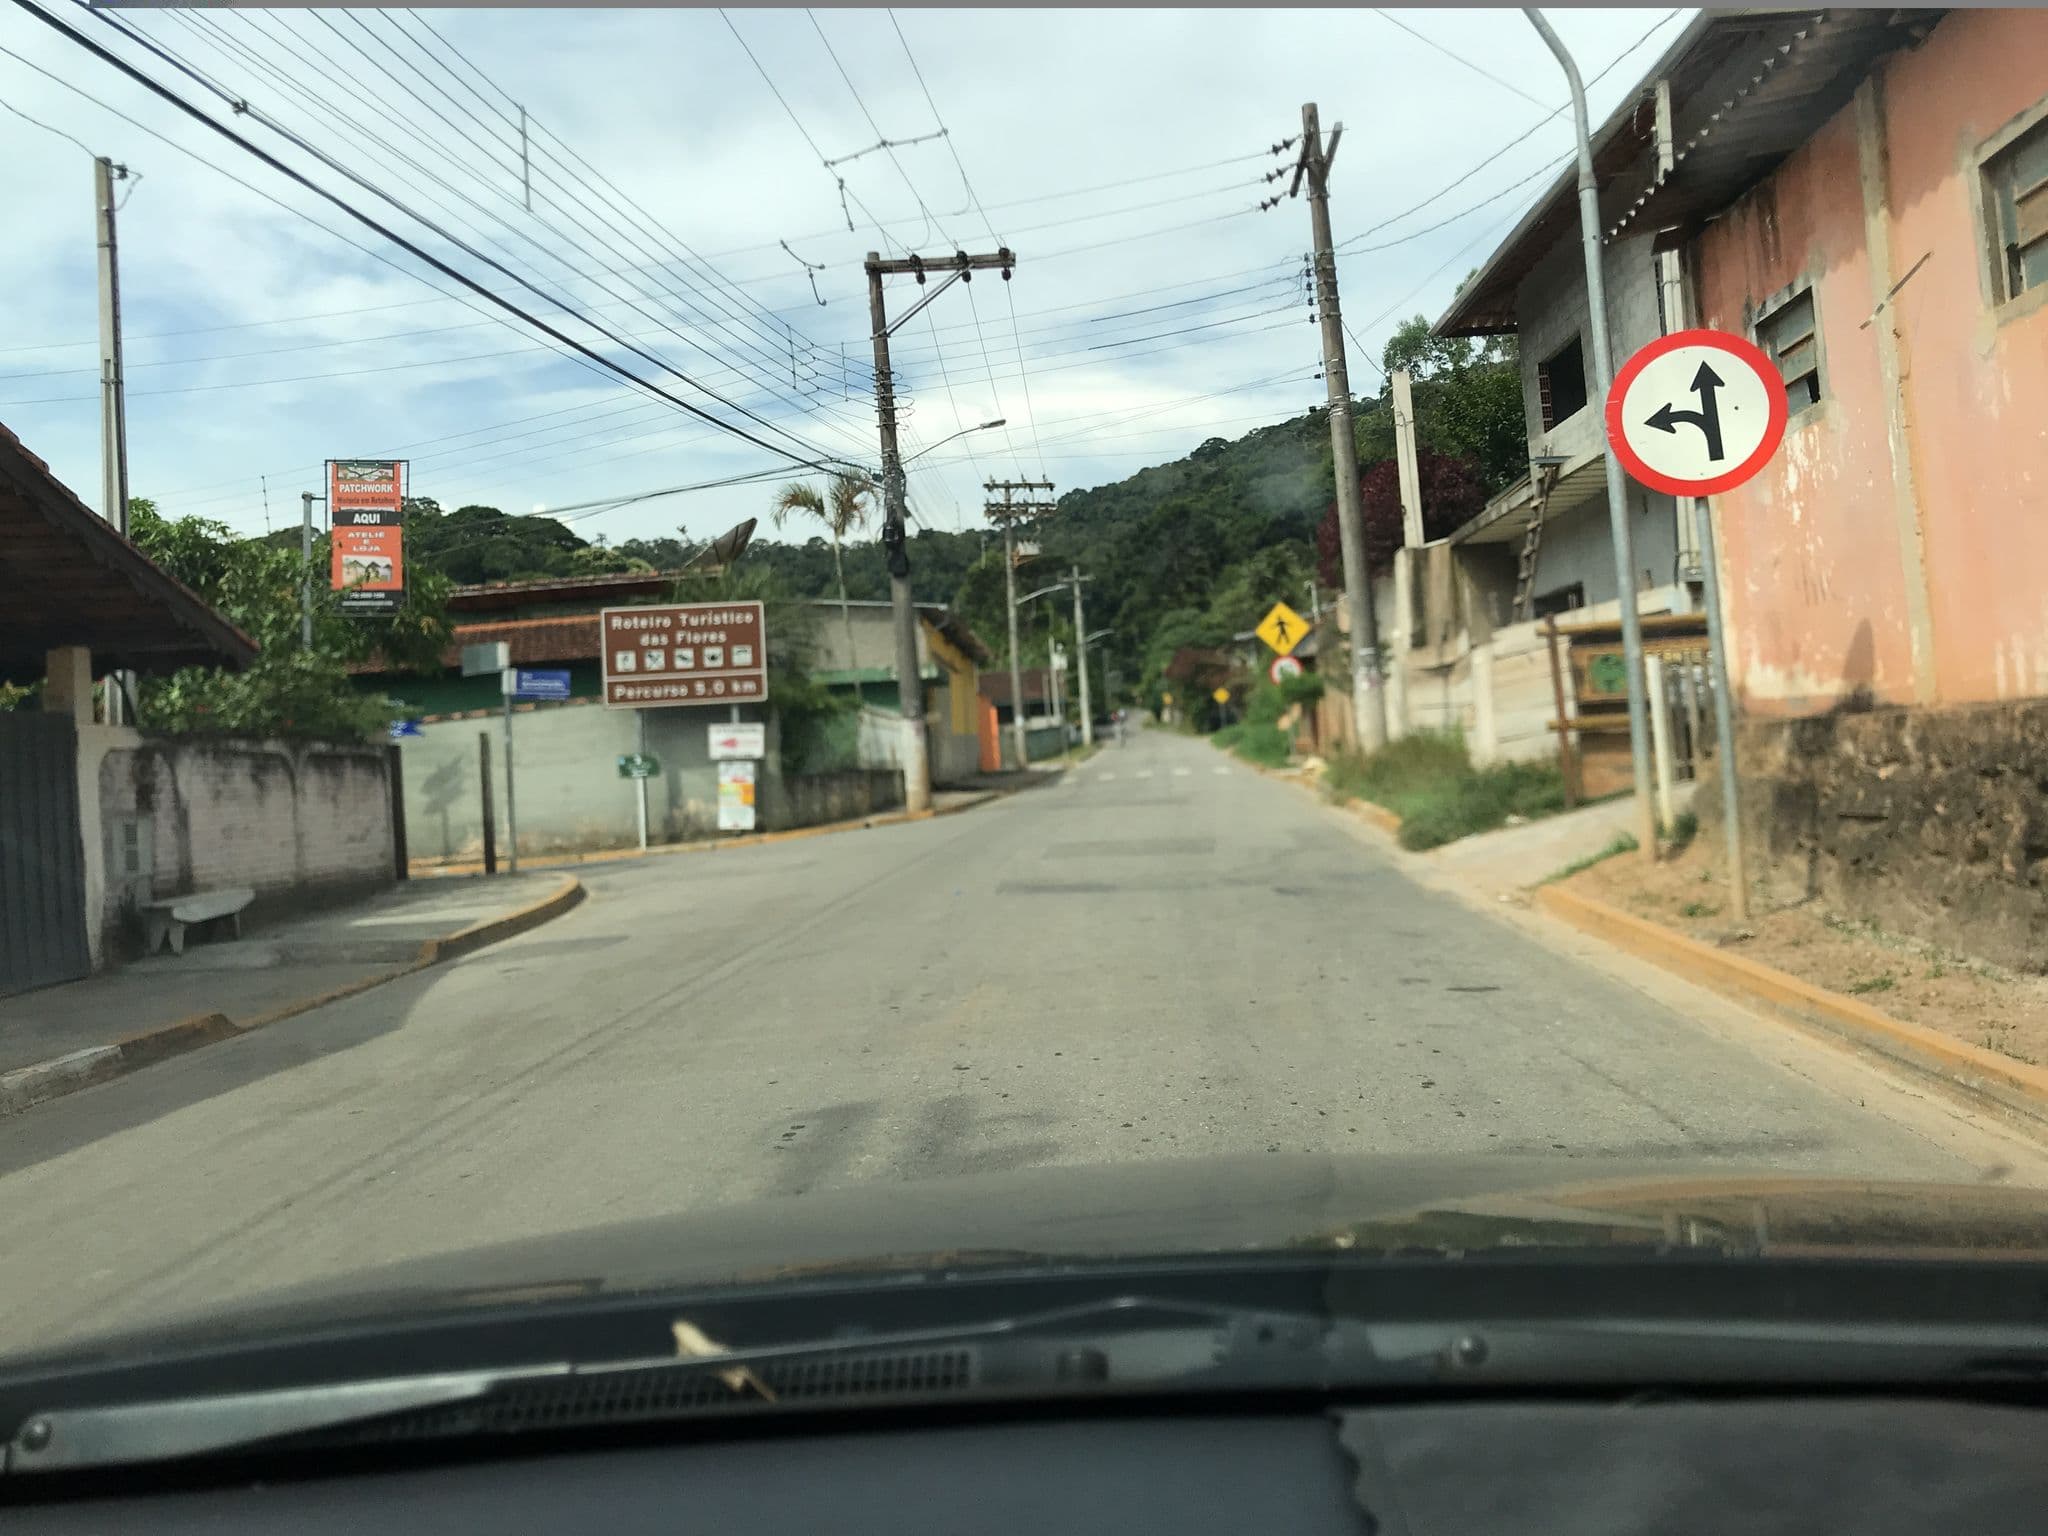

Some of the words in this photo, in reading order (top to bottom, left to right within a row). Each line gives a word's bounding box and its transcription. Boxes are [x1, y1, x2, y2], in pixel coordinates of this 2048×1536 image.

[339, 484, 394, 493] PATCHWORK
[353, 513, 381, 525] AQUI
[610, 616, 672, 631] Roteiro
[639, 632, 669, 646] das
[676, 631, 727, 644] Flores
[613, 684, 689, 700] Percurso
[731, 679, 757, 694] km
